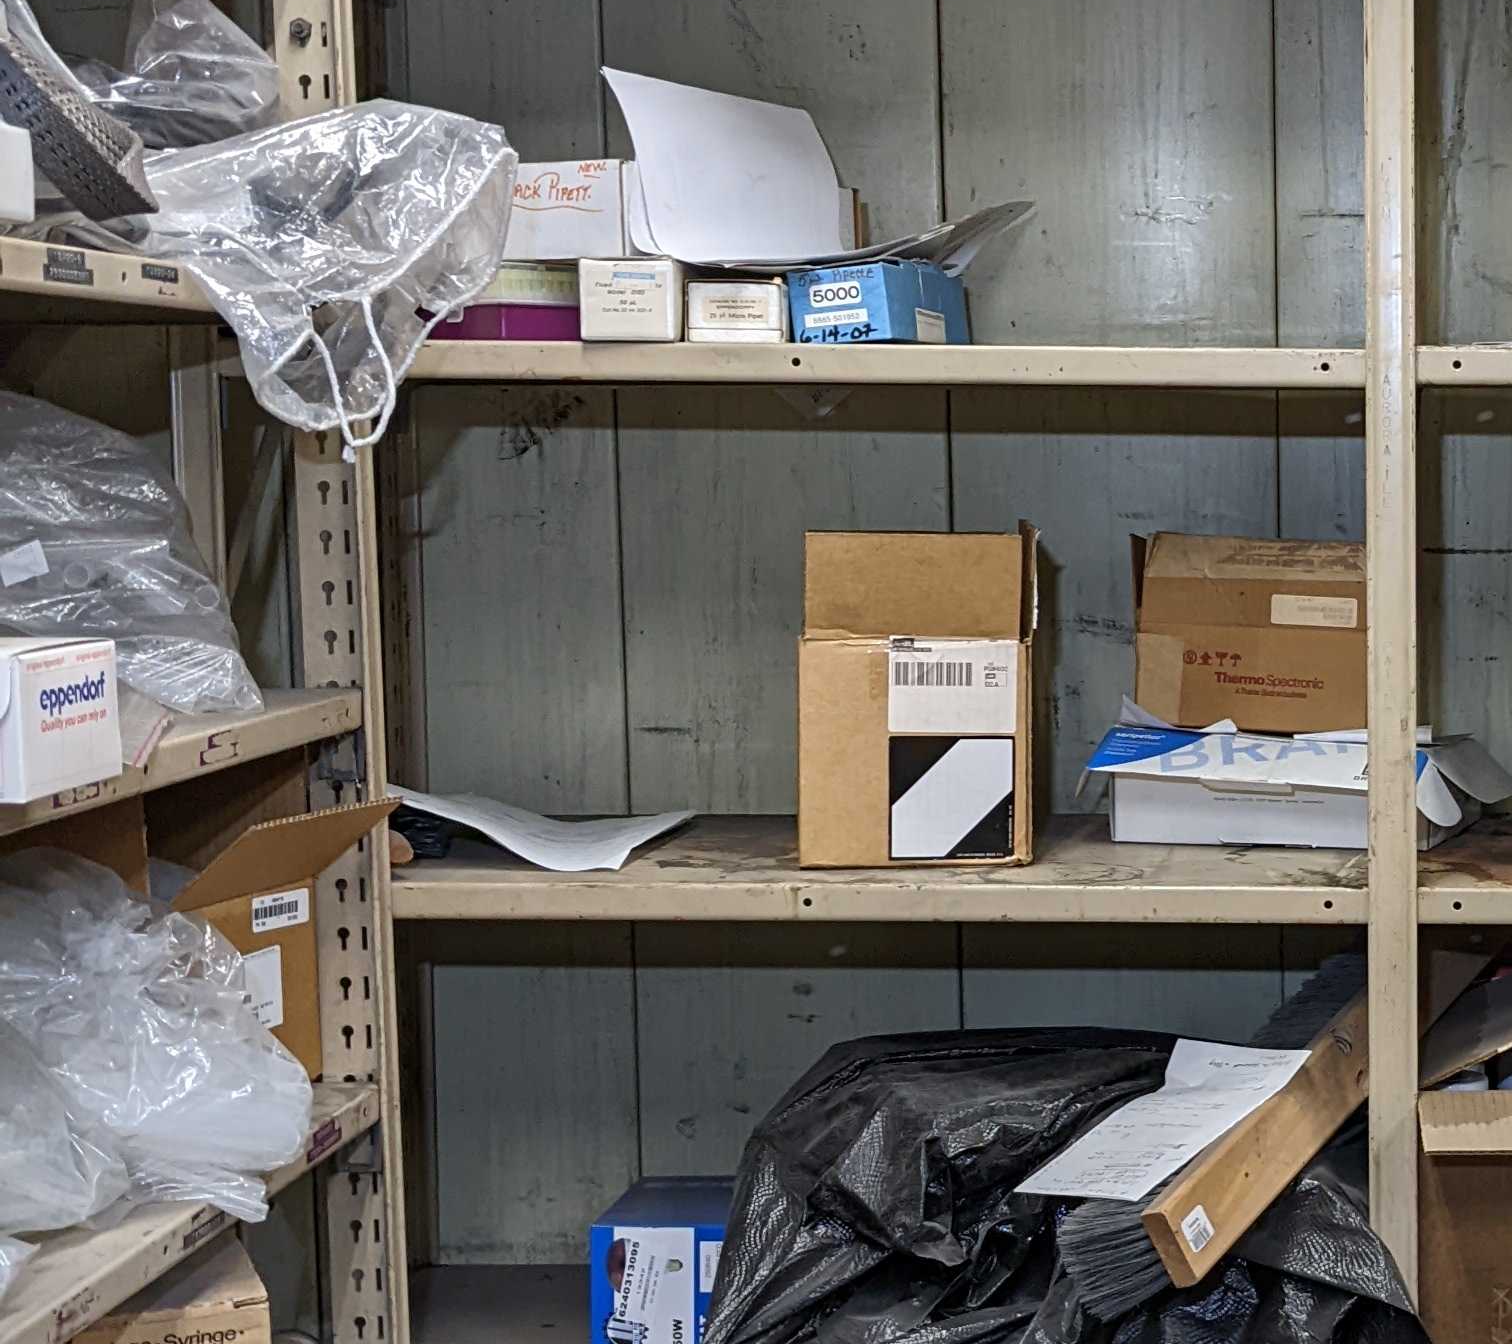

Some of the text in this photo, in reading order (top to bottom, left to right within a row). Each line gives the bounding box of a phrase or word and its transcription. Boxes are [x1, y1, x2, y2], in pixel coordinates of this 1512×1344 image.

[812, 285, 860, 303] 5000
[800, 323, 878, 343] 6-14-07
[1214, 671, 1325, 689] Thermo Spectronic
[40, 671, 105, 716] eppendorf
[40, 718, 64, 733] Quality
[64, 716, 77, 728] you
[1160, 735, 1350, 773] BRA
